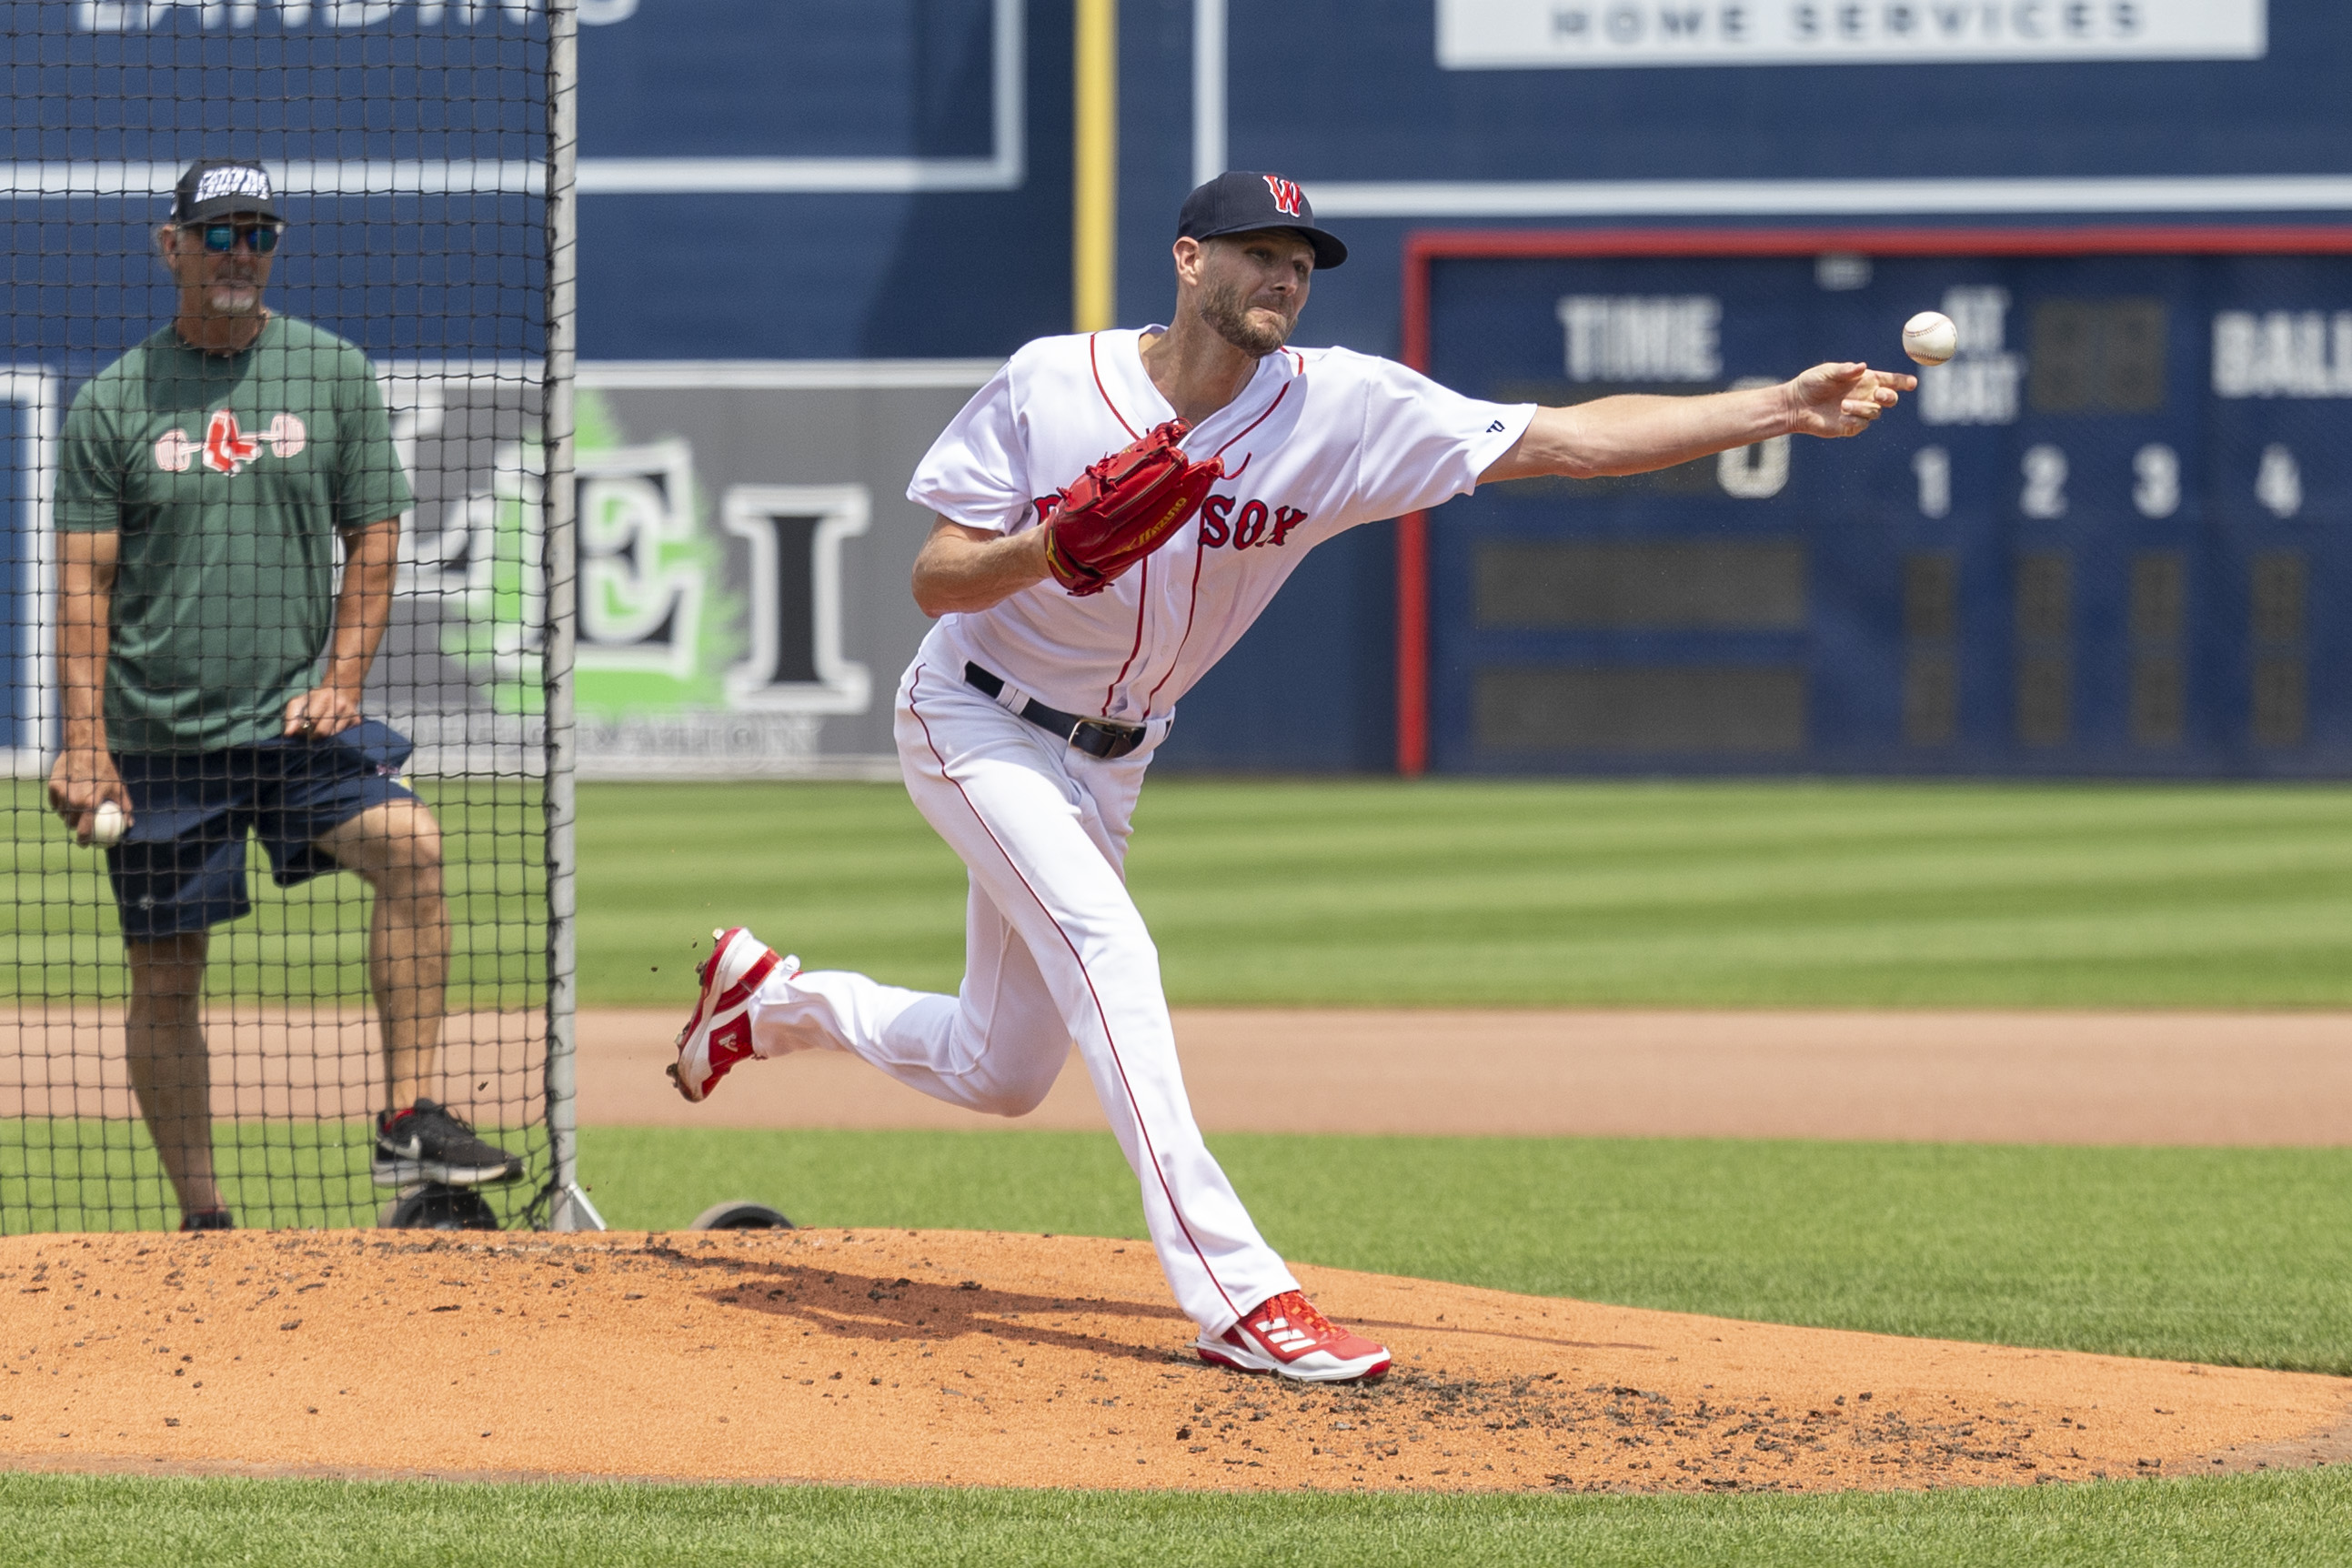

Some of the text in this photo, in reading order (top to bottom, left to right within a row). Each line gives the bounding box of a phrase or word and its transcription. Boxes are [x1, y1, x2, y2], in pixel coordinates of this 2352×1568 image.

[1549, 0, 2143, 45] HOME SERVICES
[1262, 175, 1302, 217] W
[1557, 296, 1723, 381] TIME
[1918, 354, 2026, 425] BAT
[1915, 444, 2302, 518] 1 2 3 4
[1197, 494, 1308, 551] SOX
